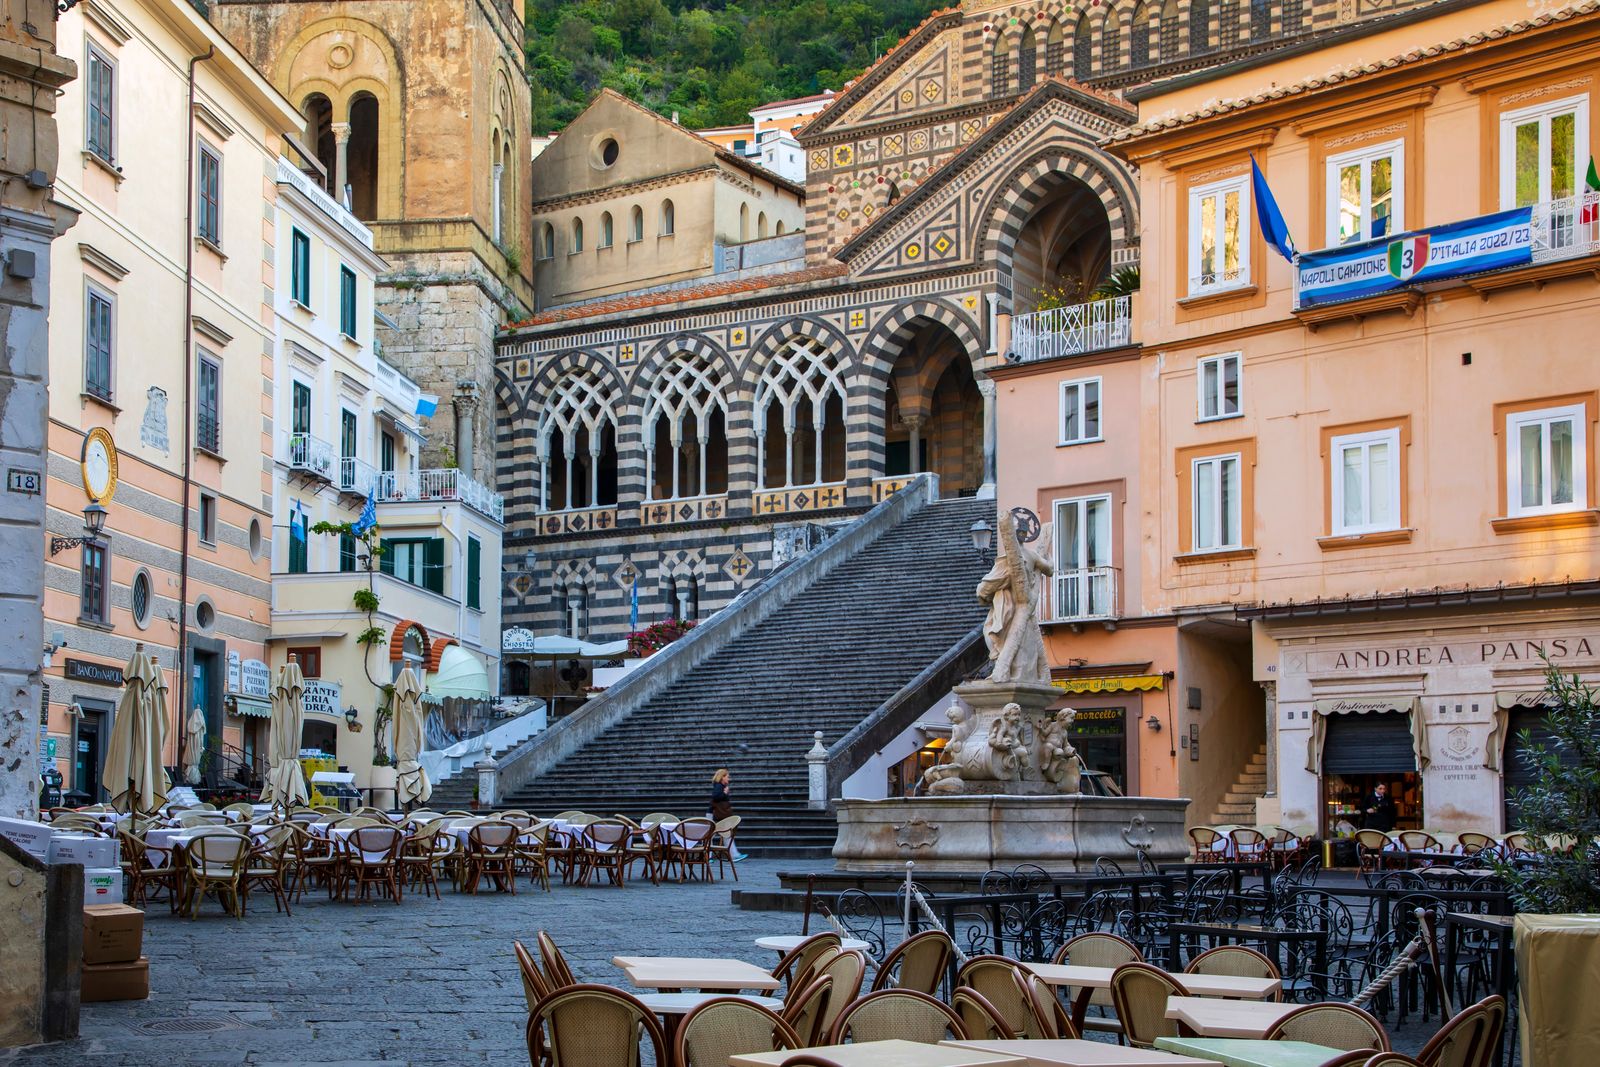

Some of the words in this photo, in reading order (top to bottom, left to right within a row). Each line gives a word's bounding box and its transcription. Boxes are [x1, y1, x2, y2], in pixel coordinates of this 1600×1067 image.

[1301, 269, 1335, 287] NAPOLI
[1337, 258, 1386, 281] CAMPIONE
[1402, 249, 1413, 269] 3
[1431, 240, 1477, 261] D'ITALIA
[1479, 228, 1530, 251] 2022/23
[15, 475, 35, 489] 18
[504, 628, 533, 642] RISTORANTE
[1335, 646, 1453, 669] ANDREA
[1481, 638, 1593, 662] PANSA
[77, 663, 97, 679] BANCO
[102, 669, 122, 683] NAPOLI
[243, 666, 269, 678] RISTORANTE
[1266, 665, 1276, 673] 40
[246, 676, 266, 687] PIZZERIA
[304, 687, 338, 698] RANTE
[304, 695, 330, 705] ERIA
[1332, 700, 1388, 711] Pasticceria
[305, 704, 334, 714] DREA
[1074, 709, 1117, 720] moncello
